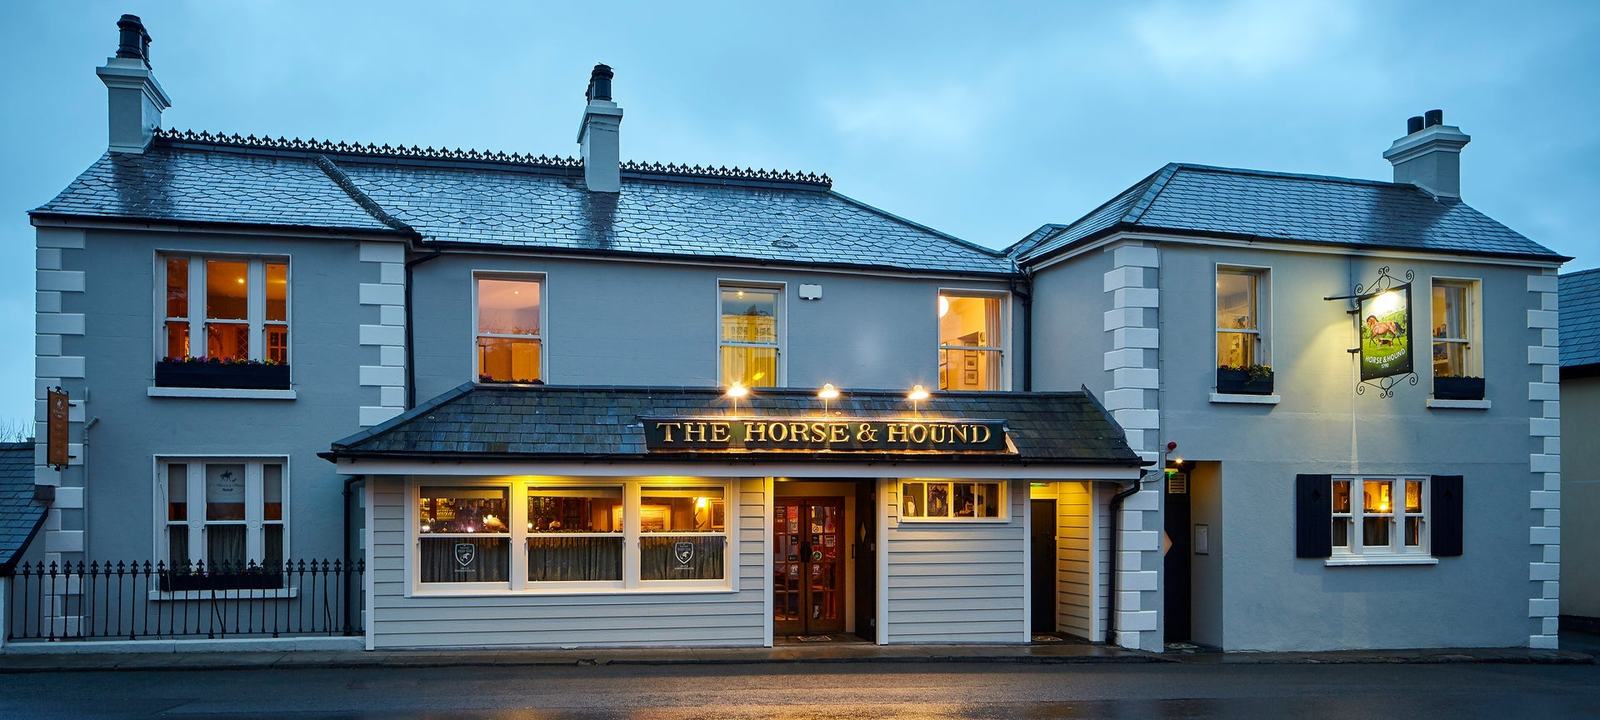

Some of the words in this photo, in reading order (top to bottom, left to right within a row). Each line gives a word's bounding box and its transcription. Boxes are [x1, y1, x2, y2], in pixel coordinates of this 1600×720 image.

[656, 422, 731, 442] THE
[743, 422, 850, 443] HORSE
[857, 423, 879, 442] &
[887, 424, 991, 444] HOUND
